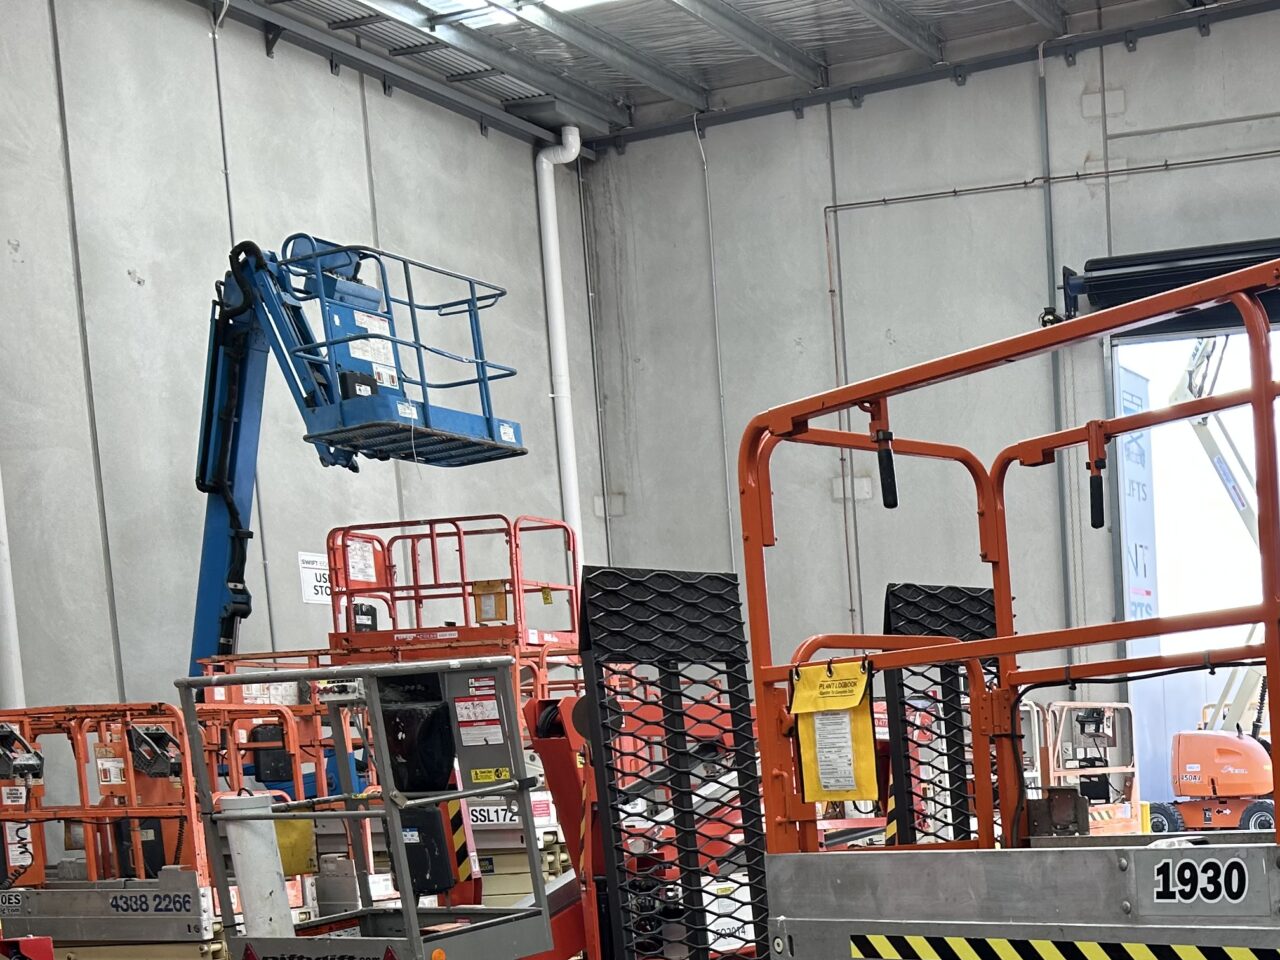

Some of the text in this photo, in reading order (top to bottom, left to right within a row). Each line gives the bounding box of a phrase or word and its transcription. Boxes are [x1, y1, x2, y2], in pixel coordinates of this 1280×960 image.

[471, 809, 517, 823] SSL172
[1154, 858, 1247, 903] 1930
[153, 894, 192, 912] 2266
